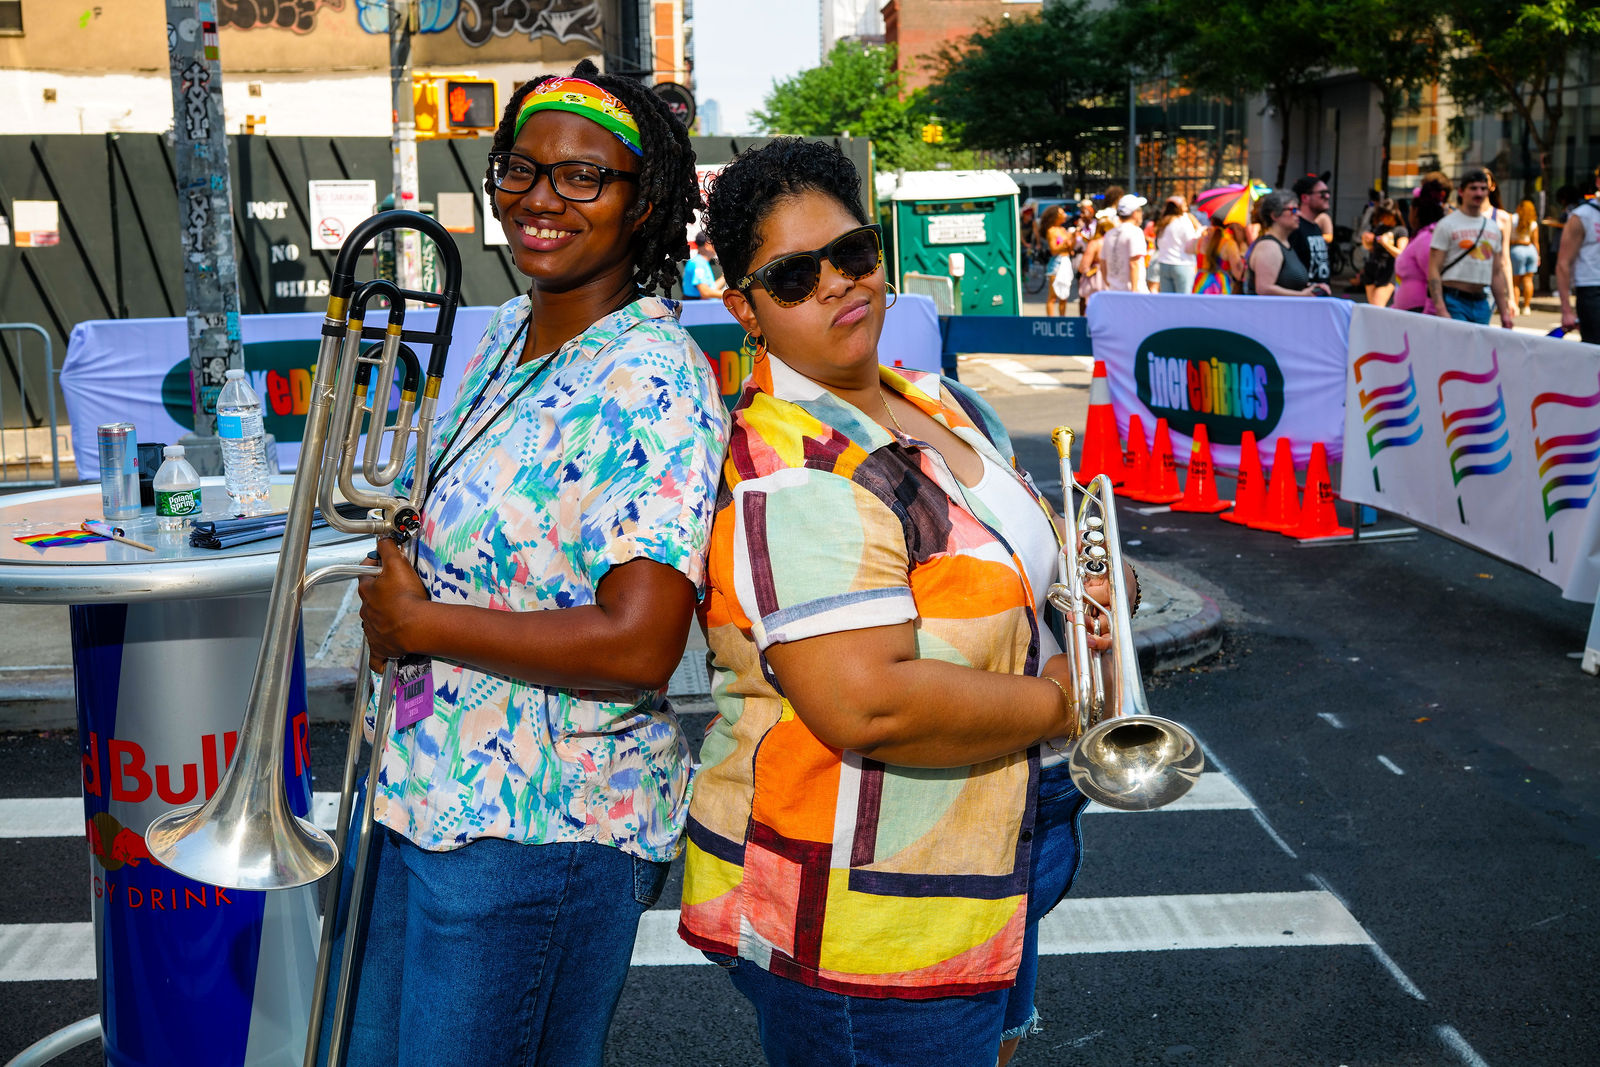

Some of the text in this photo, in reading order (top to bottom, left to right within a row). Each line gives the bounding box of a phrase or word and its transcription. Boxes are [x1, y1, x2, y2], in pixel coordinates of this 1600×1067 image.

[246, 201, 288, 220] POST
[271, 243, 300, 264] NO
[275, 279, 331, 298] BILLS
[1032, 321, 1075, 337] POLICE
[168, 492, 194, 506] Poland
[170, 500, 195, 513] Spring
[128, 886, 232, 911] DRINK
